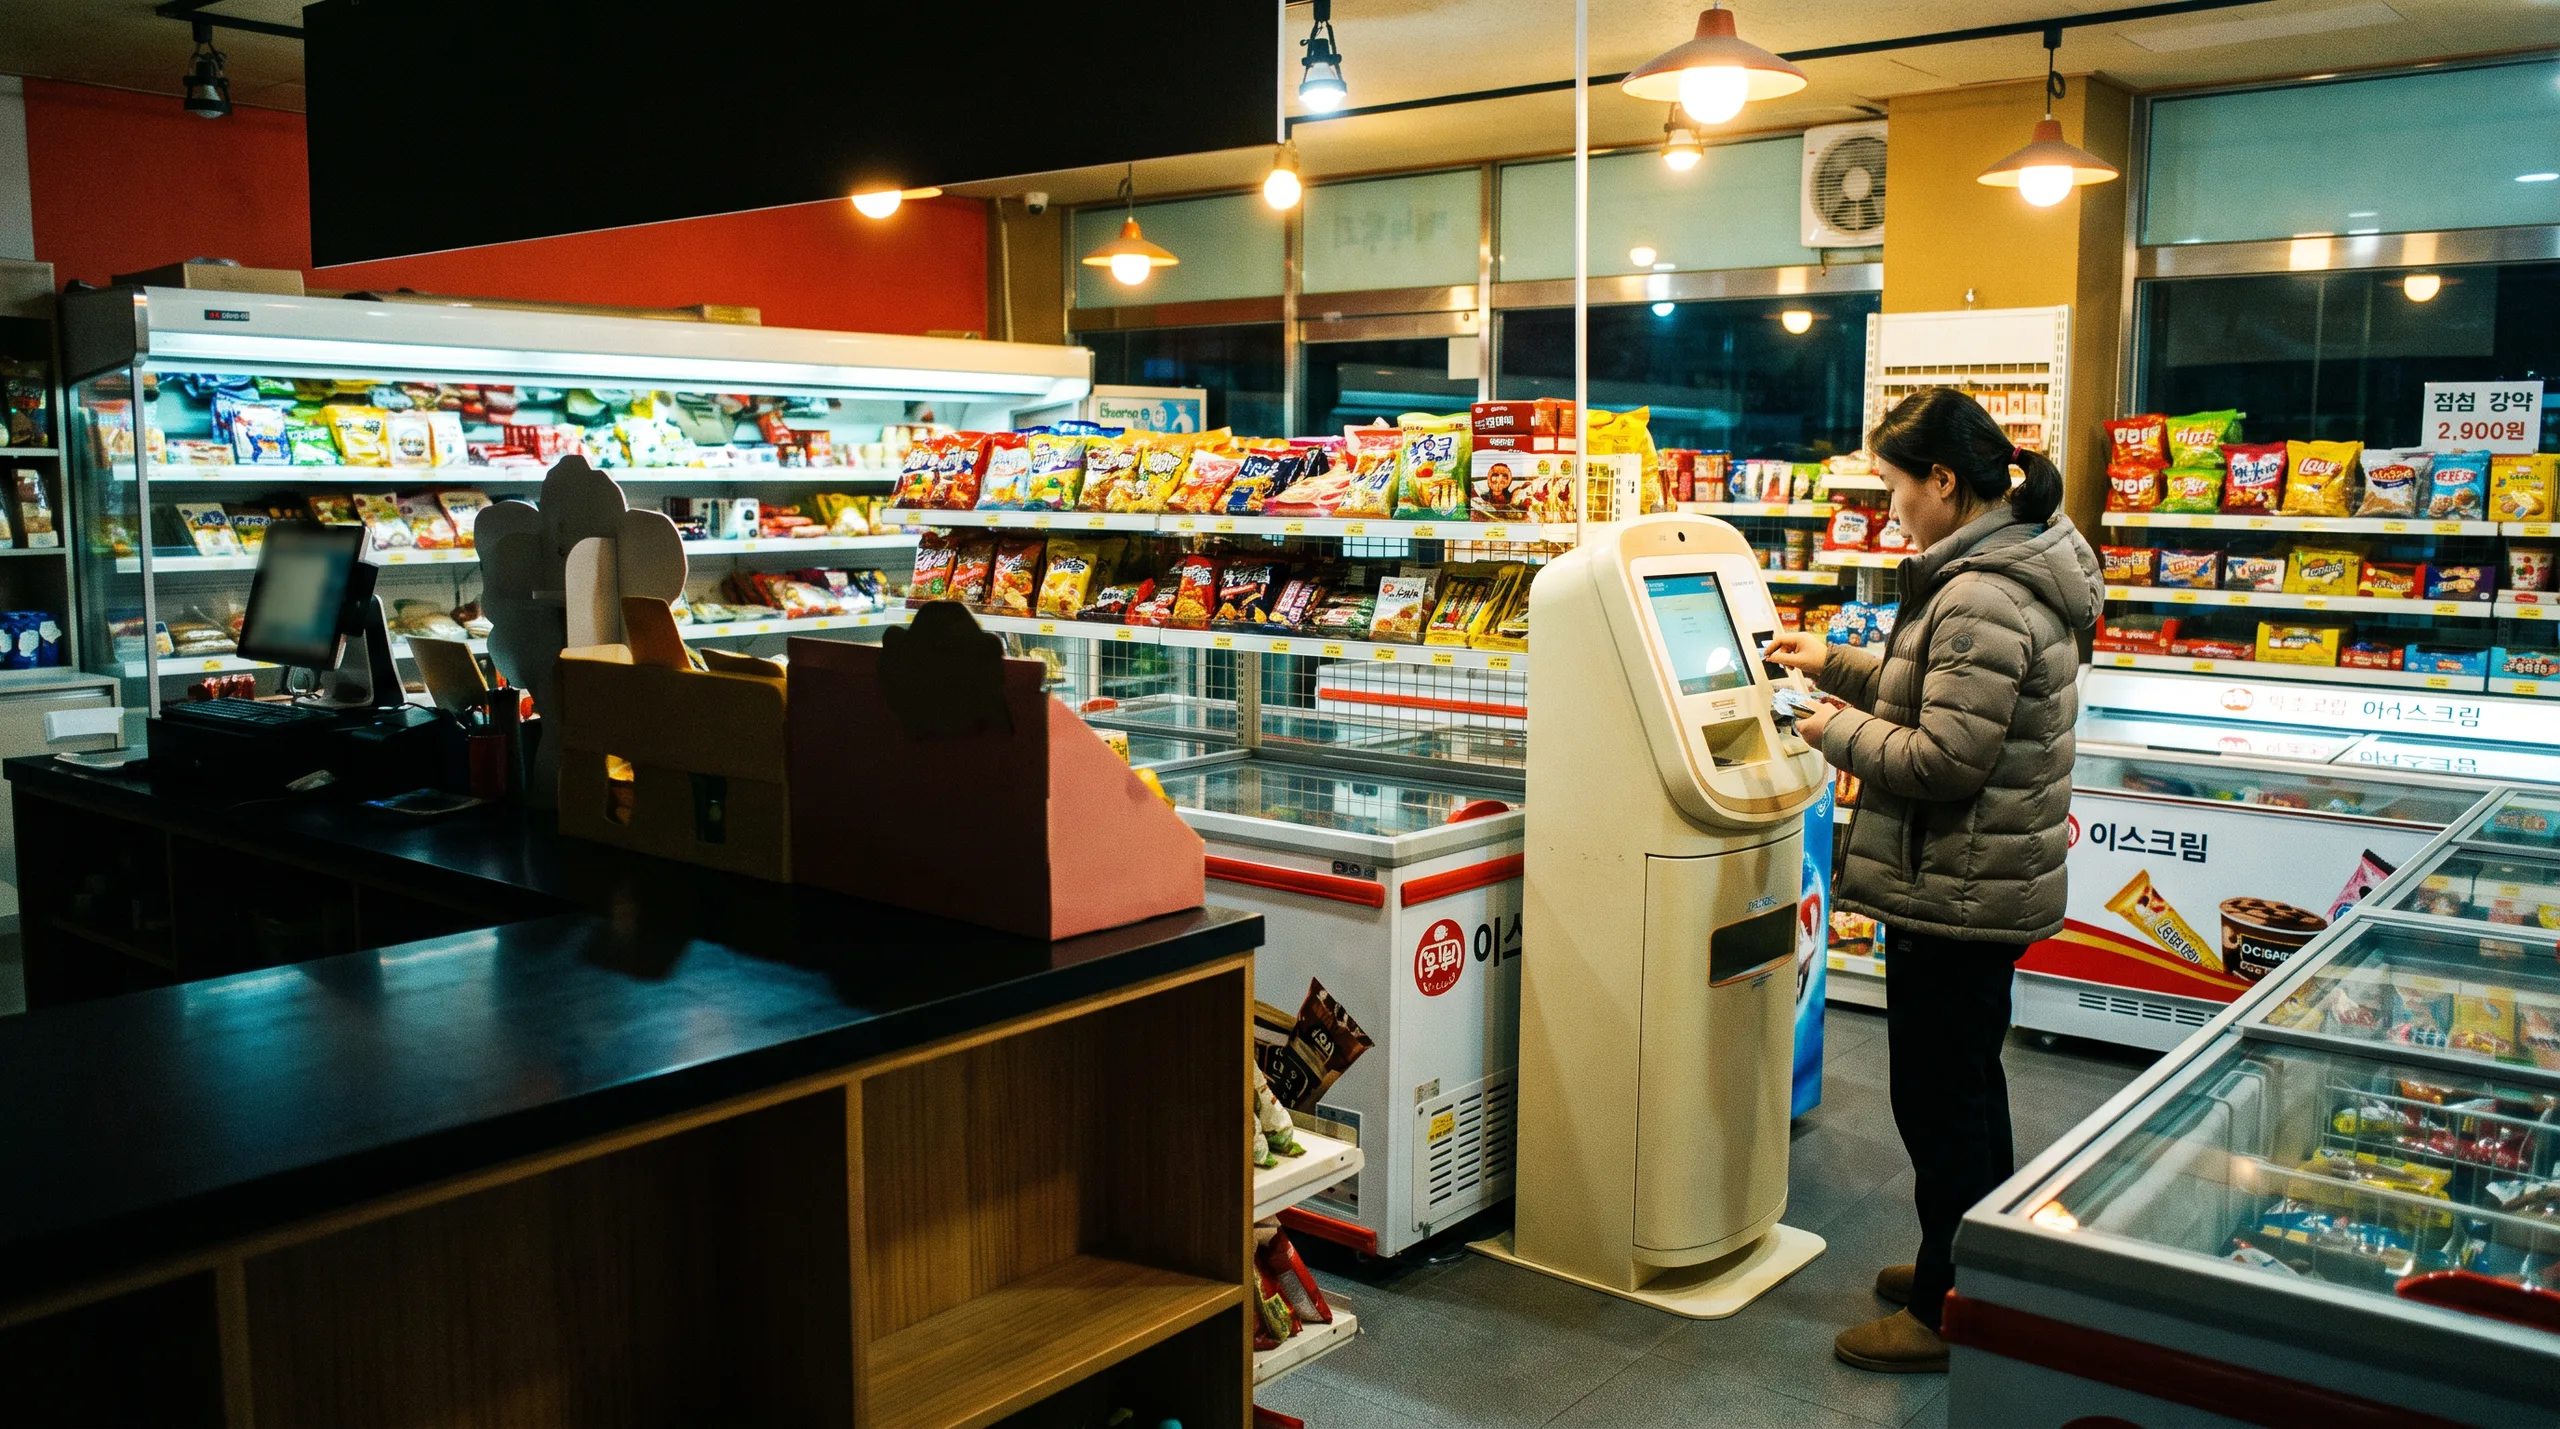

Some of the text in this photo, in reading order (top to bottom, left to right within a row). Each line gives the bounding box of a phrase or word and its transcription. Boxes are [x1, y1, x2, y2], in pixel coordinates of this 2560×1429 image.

[2490, 392, 2533, 412] 강약
[2438, 421, 2525, 441] 2,900원
[2090, 822, 2208, 864] 이스크림
